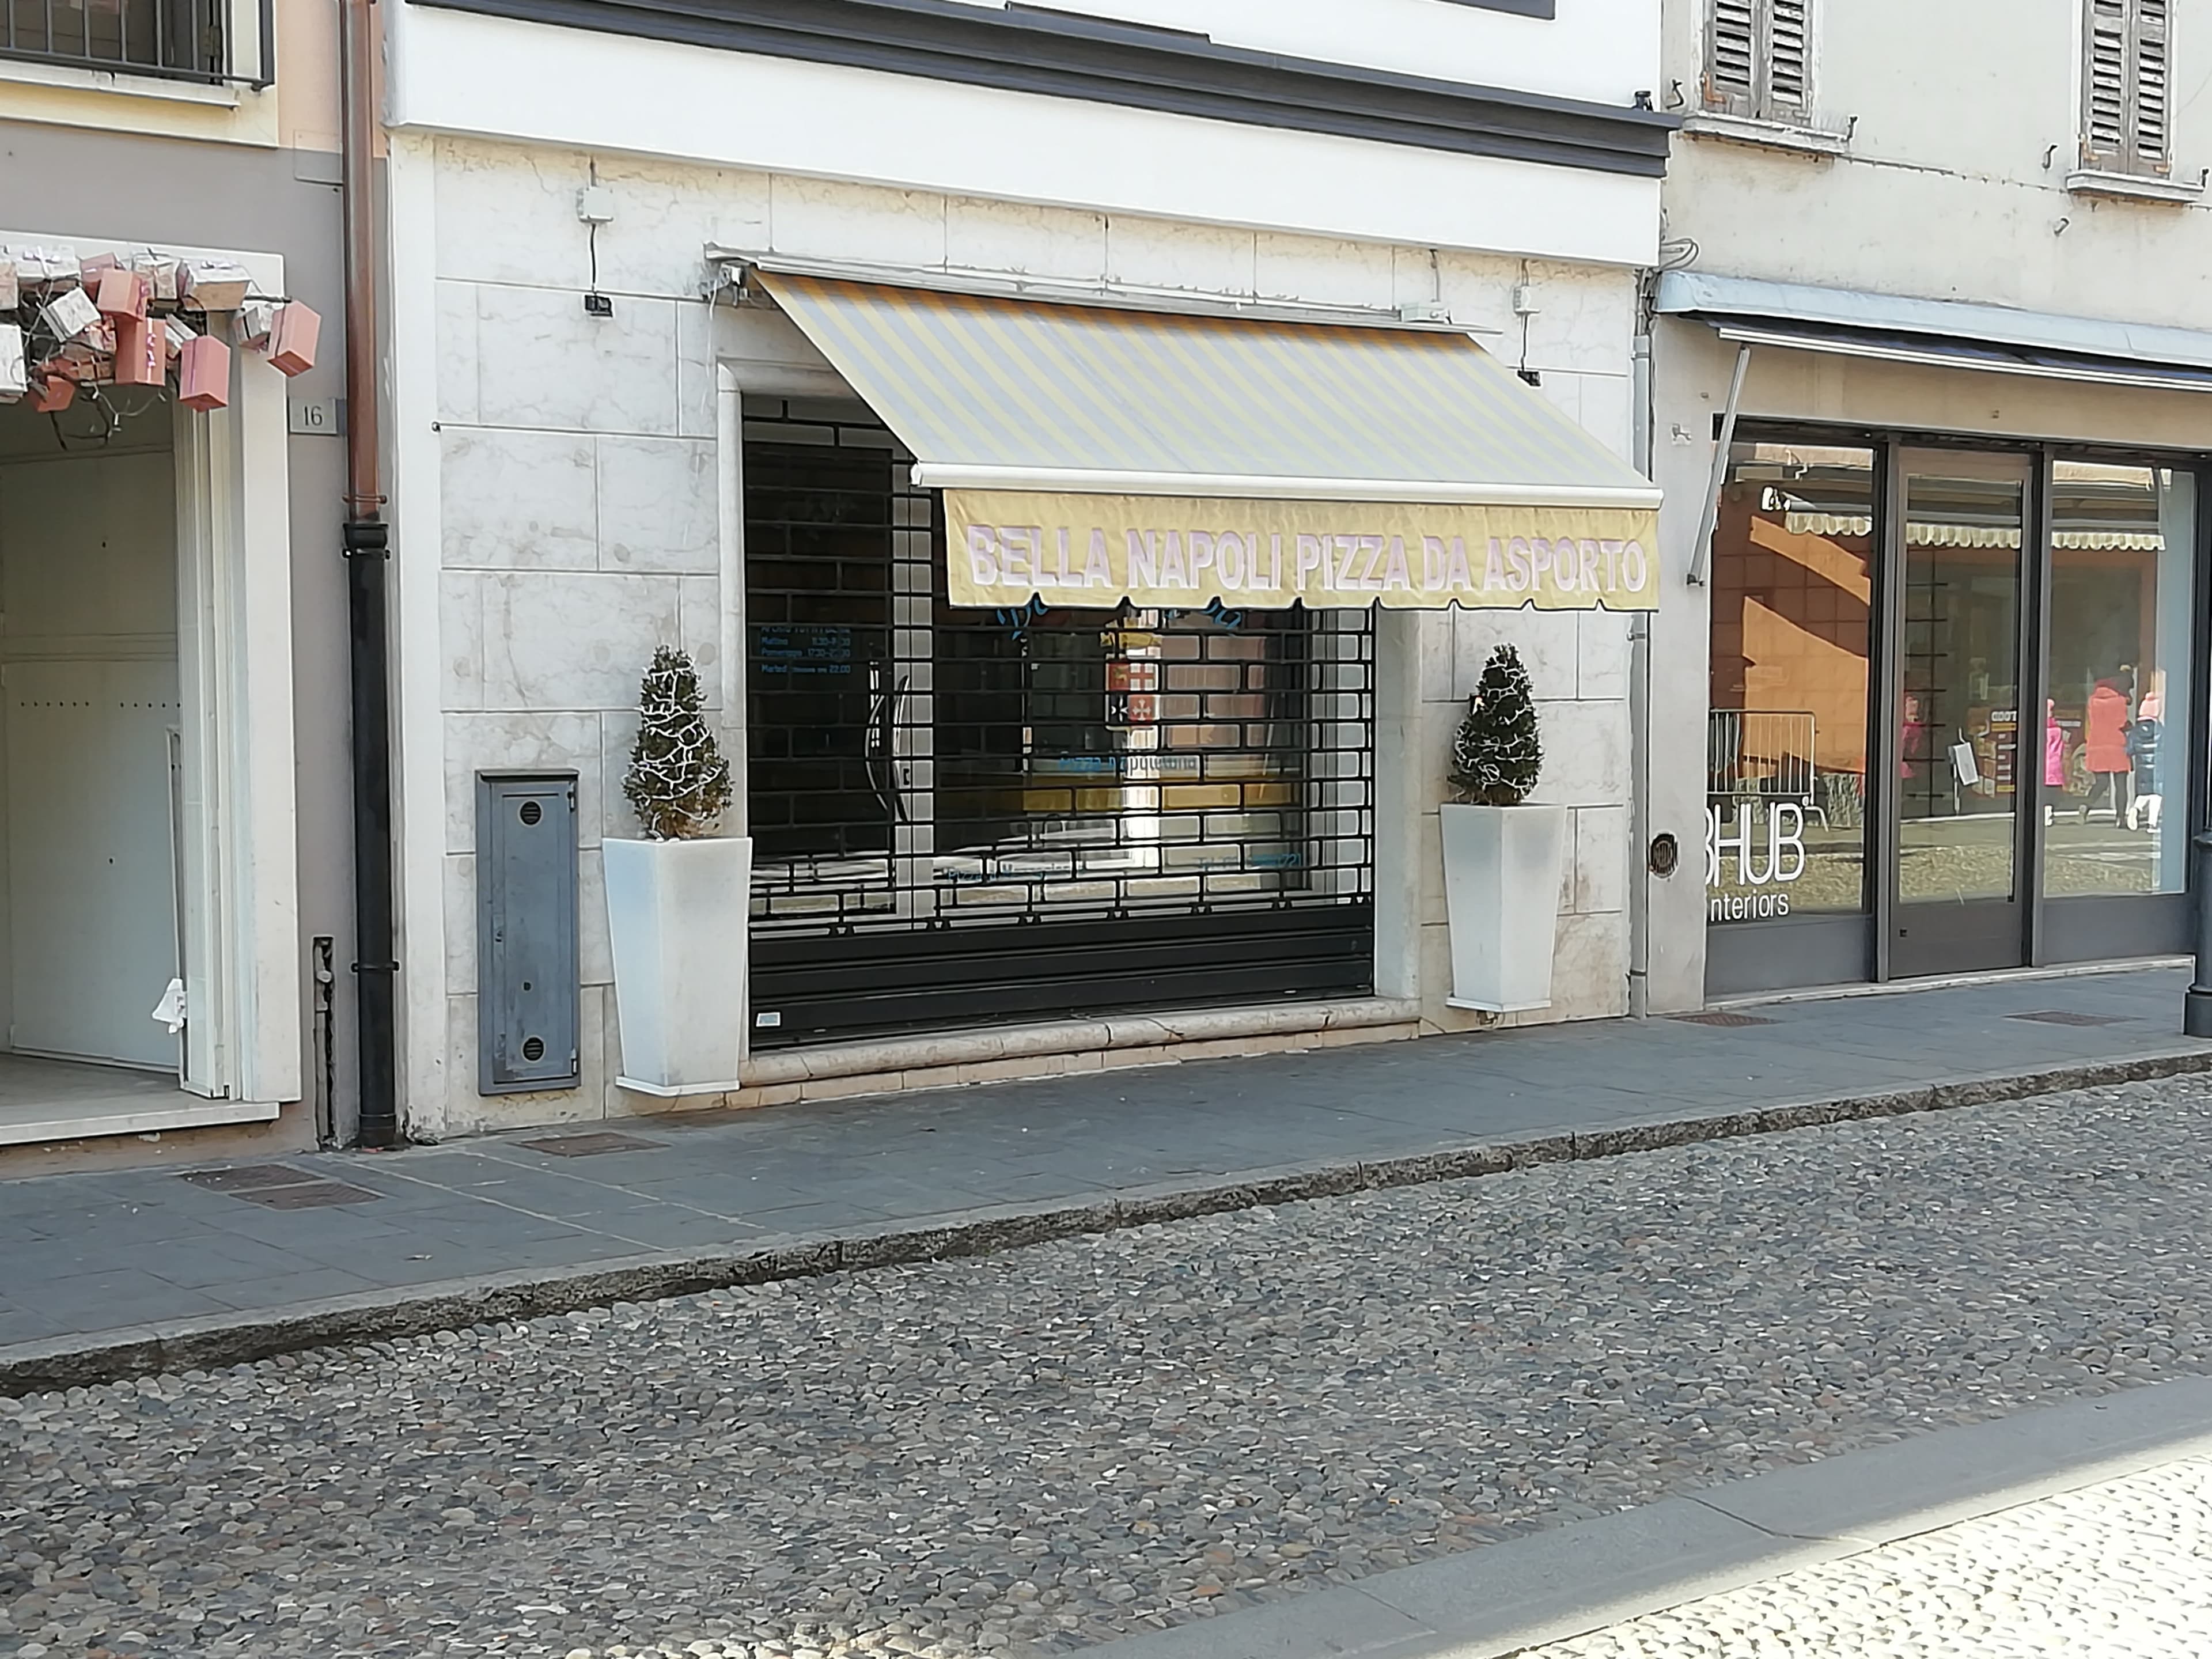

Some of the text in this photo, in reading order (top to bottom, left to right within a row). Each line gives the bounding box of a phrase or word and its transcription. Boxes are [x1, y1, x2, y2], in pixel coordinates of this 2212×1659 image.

[305, 405, 323, 426] 16
[968, 525, 1646, 592] BELLA NAPOLI PIZZA DA ASPORTO
[1709, 889, 1790, 922] nteriors
